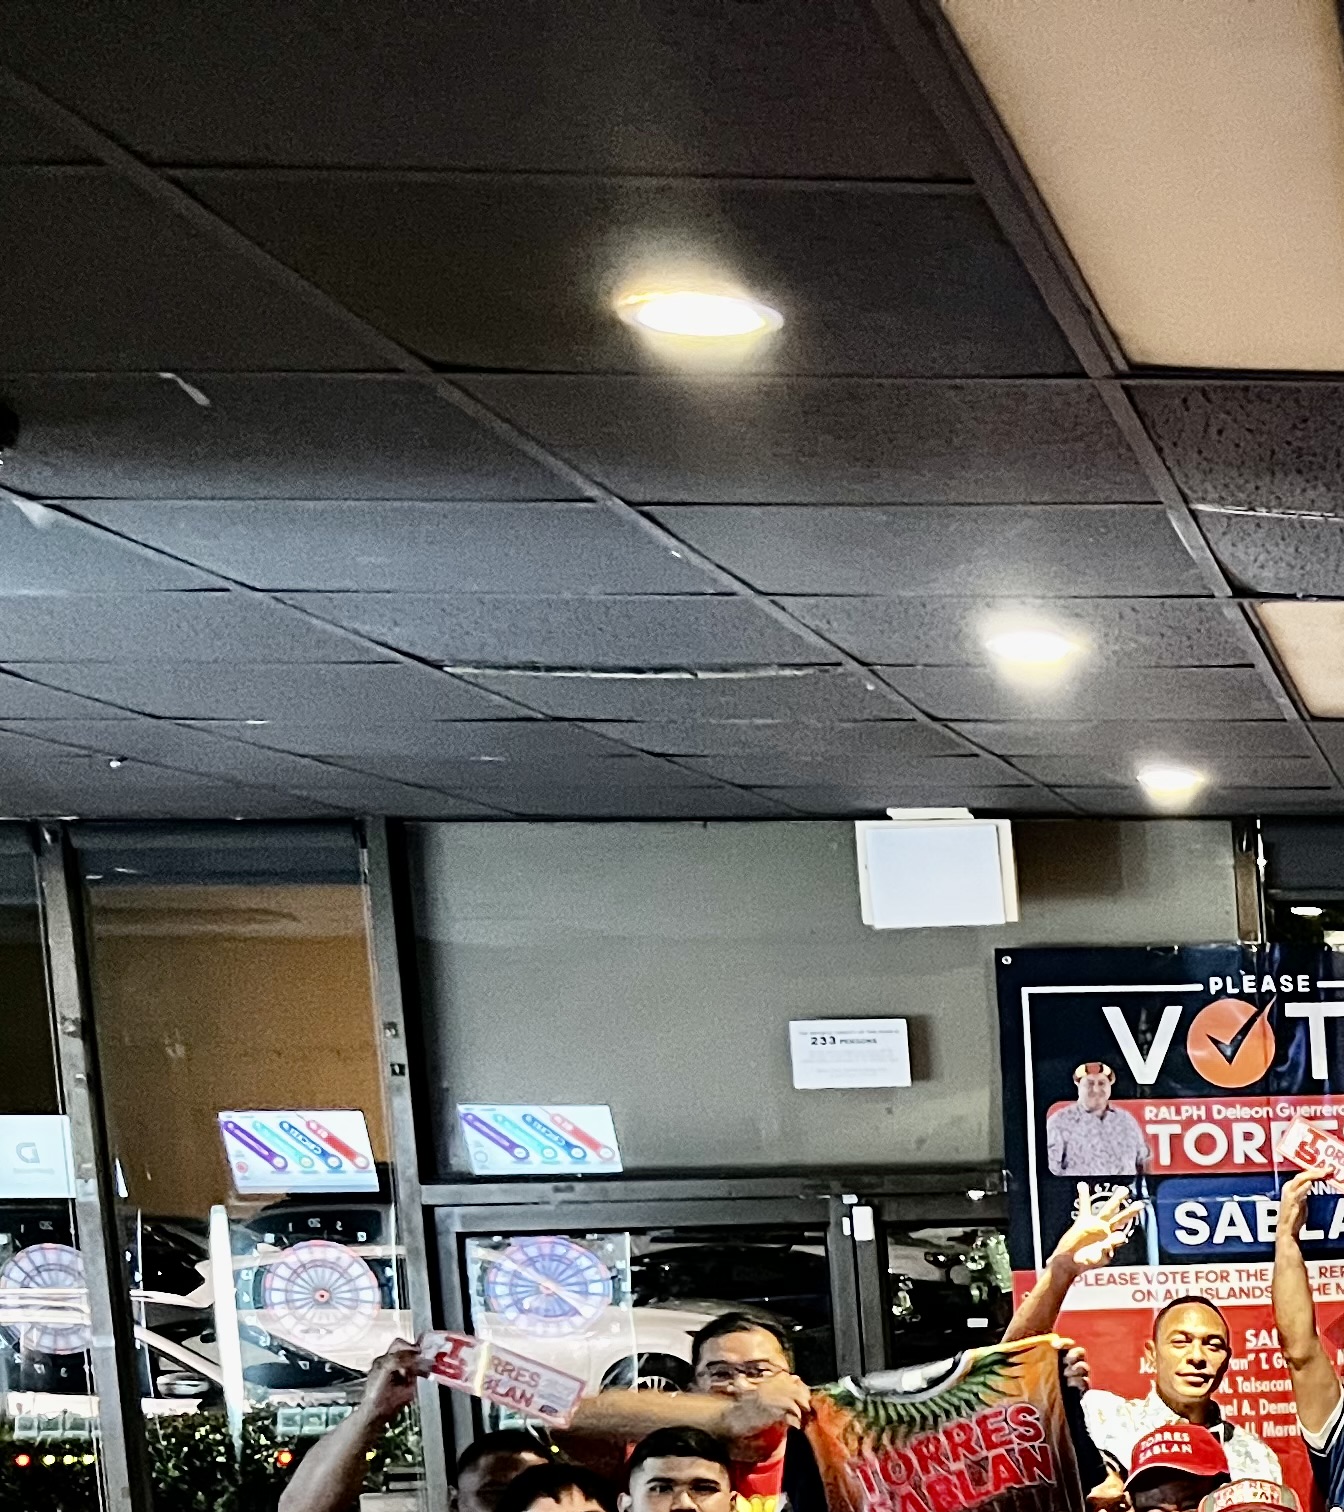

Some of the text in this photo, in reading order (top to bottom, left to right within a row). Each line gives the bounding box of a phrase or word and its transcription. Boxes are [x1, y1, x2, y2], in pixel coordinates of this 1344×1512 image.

[1209, 975, 1311, 995] PLEASE
[1144, 1106, 1206, 1121] RALPH
[1212, 1104, 1274, 1119] Deleon
[1073, 1272, 1139, 1287] PLEASE
[1144, 1270, 1192, 1286] VOTE
[1195, 1270, 1233, 1284] FOR
[1235, 1268, 1270, 1283] THE
[1131, 1289, 1159, 1304] ON
[855, 1402, 1046, 1500] TORRES
